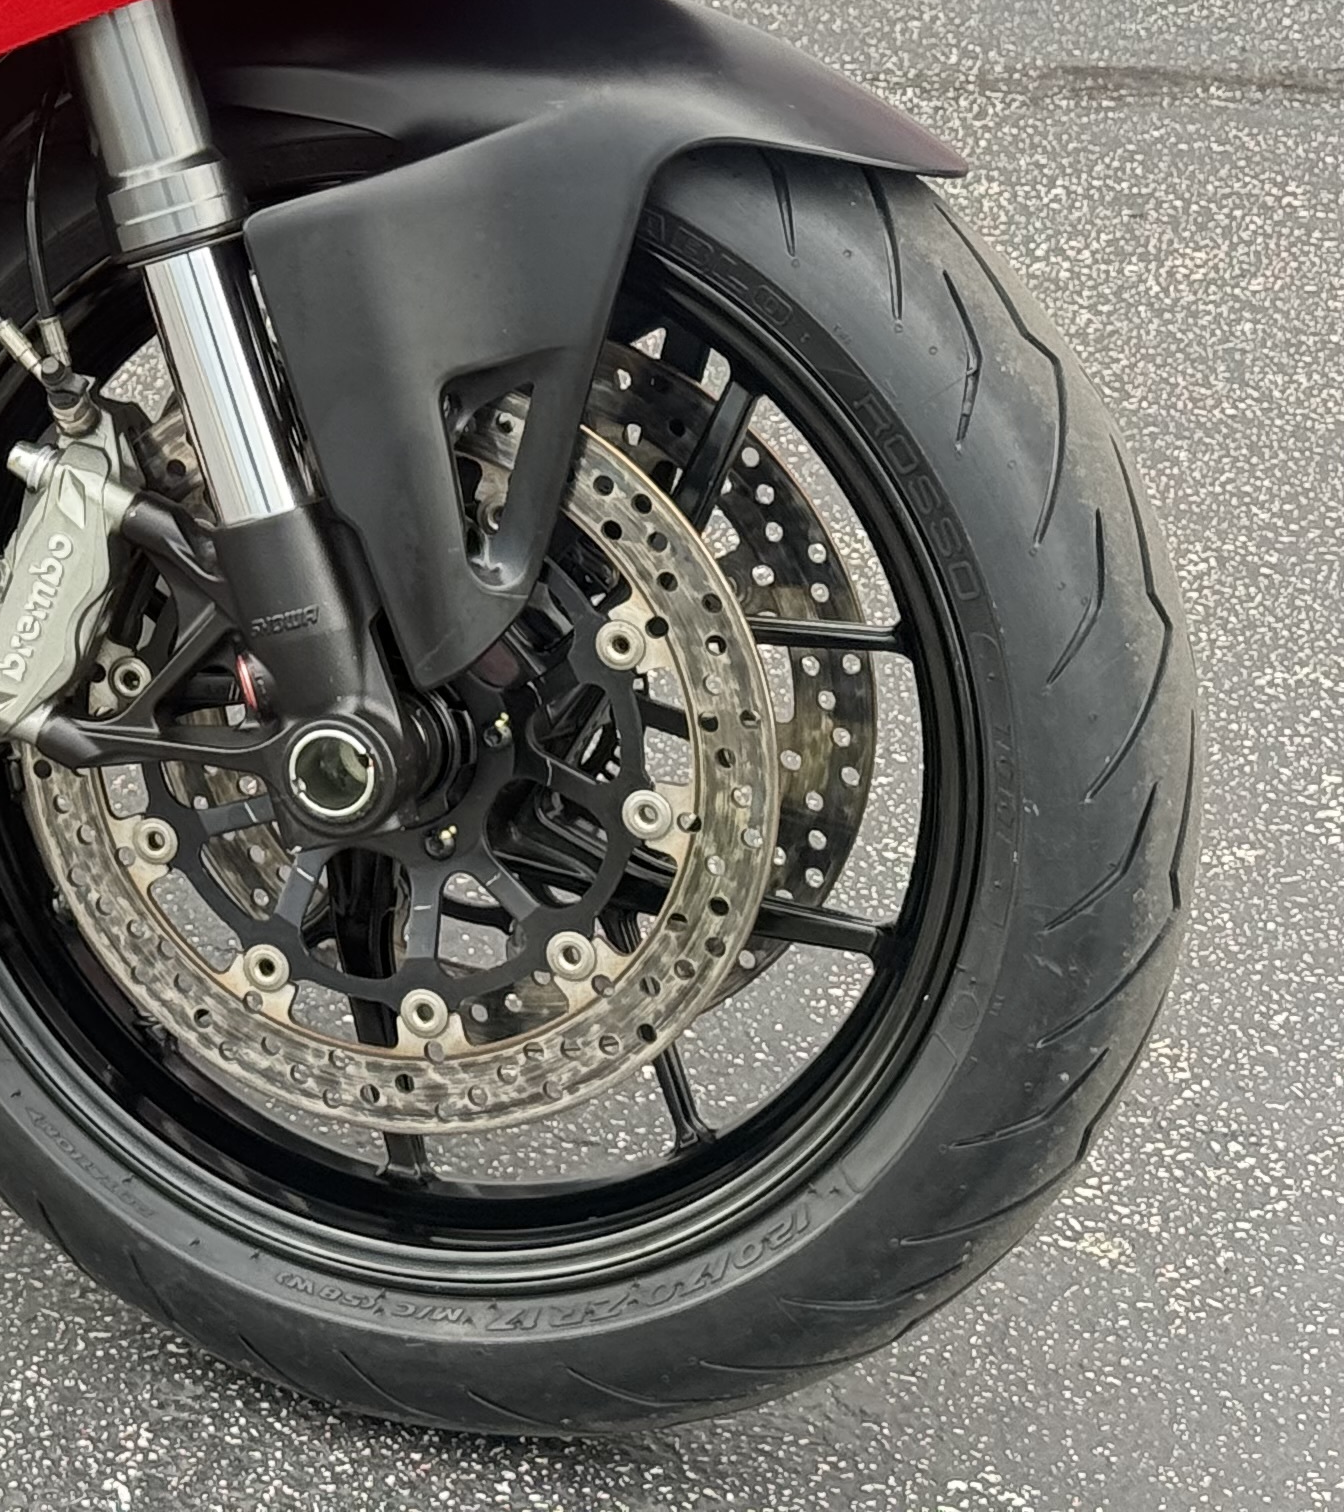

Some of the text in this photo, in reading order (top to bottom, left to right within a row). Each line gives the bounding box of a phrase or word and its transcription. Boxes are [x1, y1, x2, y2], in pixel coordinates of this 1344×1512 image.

[639, 207, 794, 327] ABLO
[852, 391, 981, 602] ROSSO
[643, 1201, 813, 1308] 120/70
[389, 1300, 464, 1325] M/C
